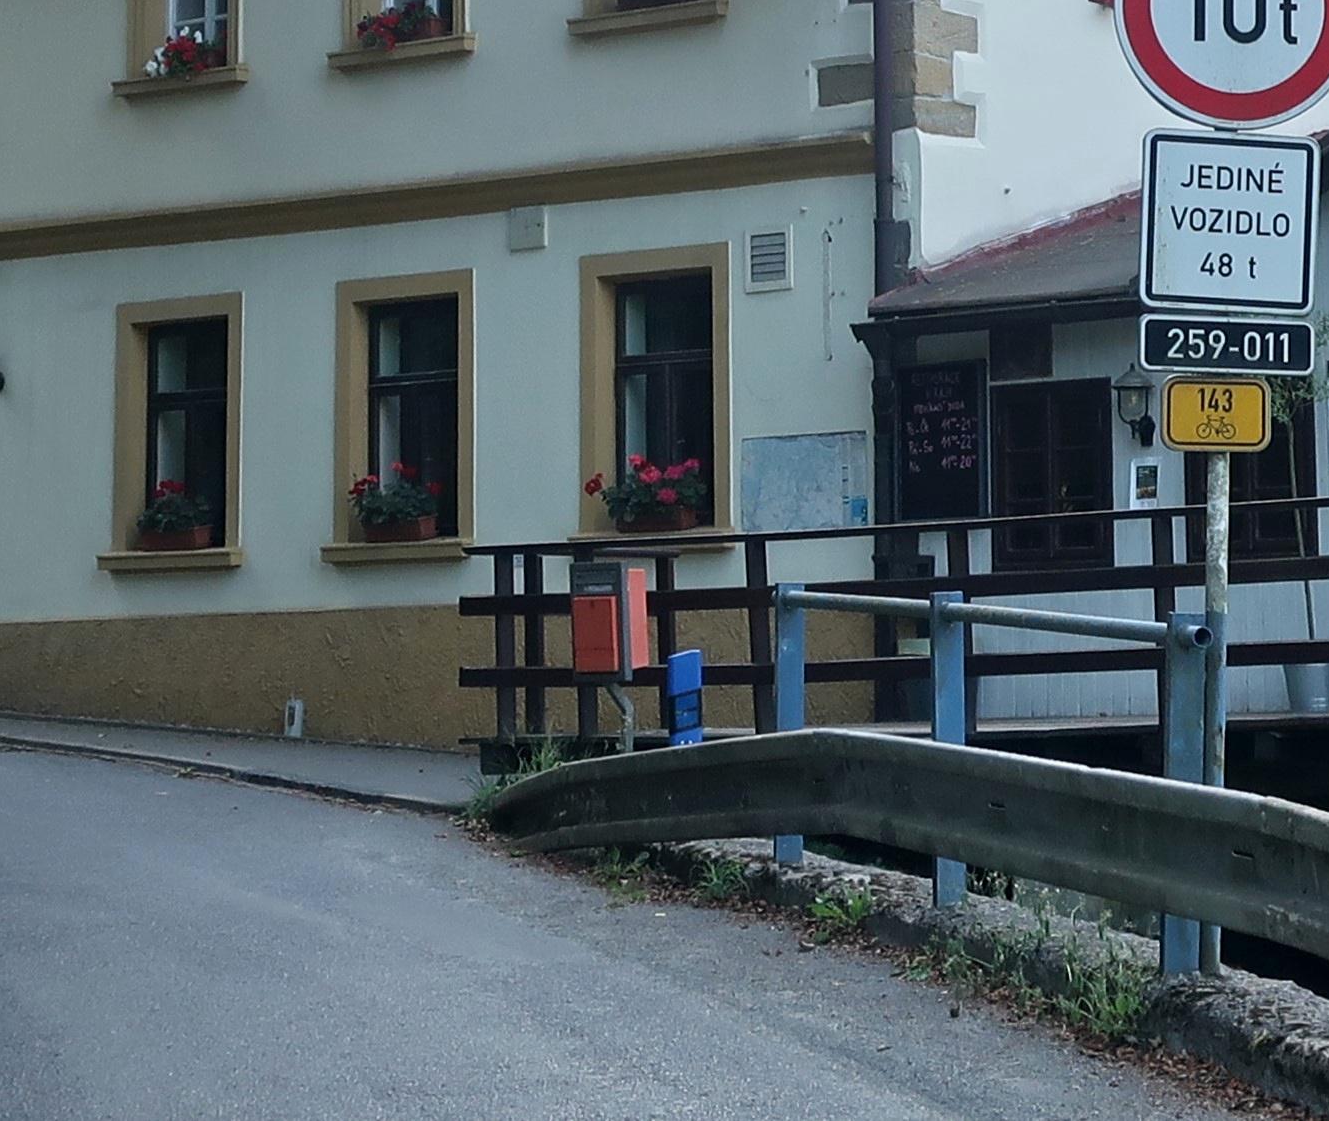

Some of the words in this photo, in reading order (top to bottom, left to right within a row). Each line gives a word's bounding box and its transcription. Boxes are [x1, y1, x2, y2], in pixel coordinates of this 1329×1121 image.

[1180, 162, 1284, 194] JEDINÉ
[1170, 205, 1291, 238] VOZIDLO
[1199, 251, 1233, 278] 48
[1248, 255, 1258, 280] t
[1166, 327, 1290, 363] 259-011
[1197, 387, 1233, 414] 143
